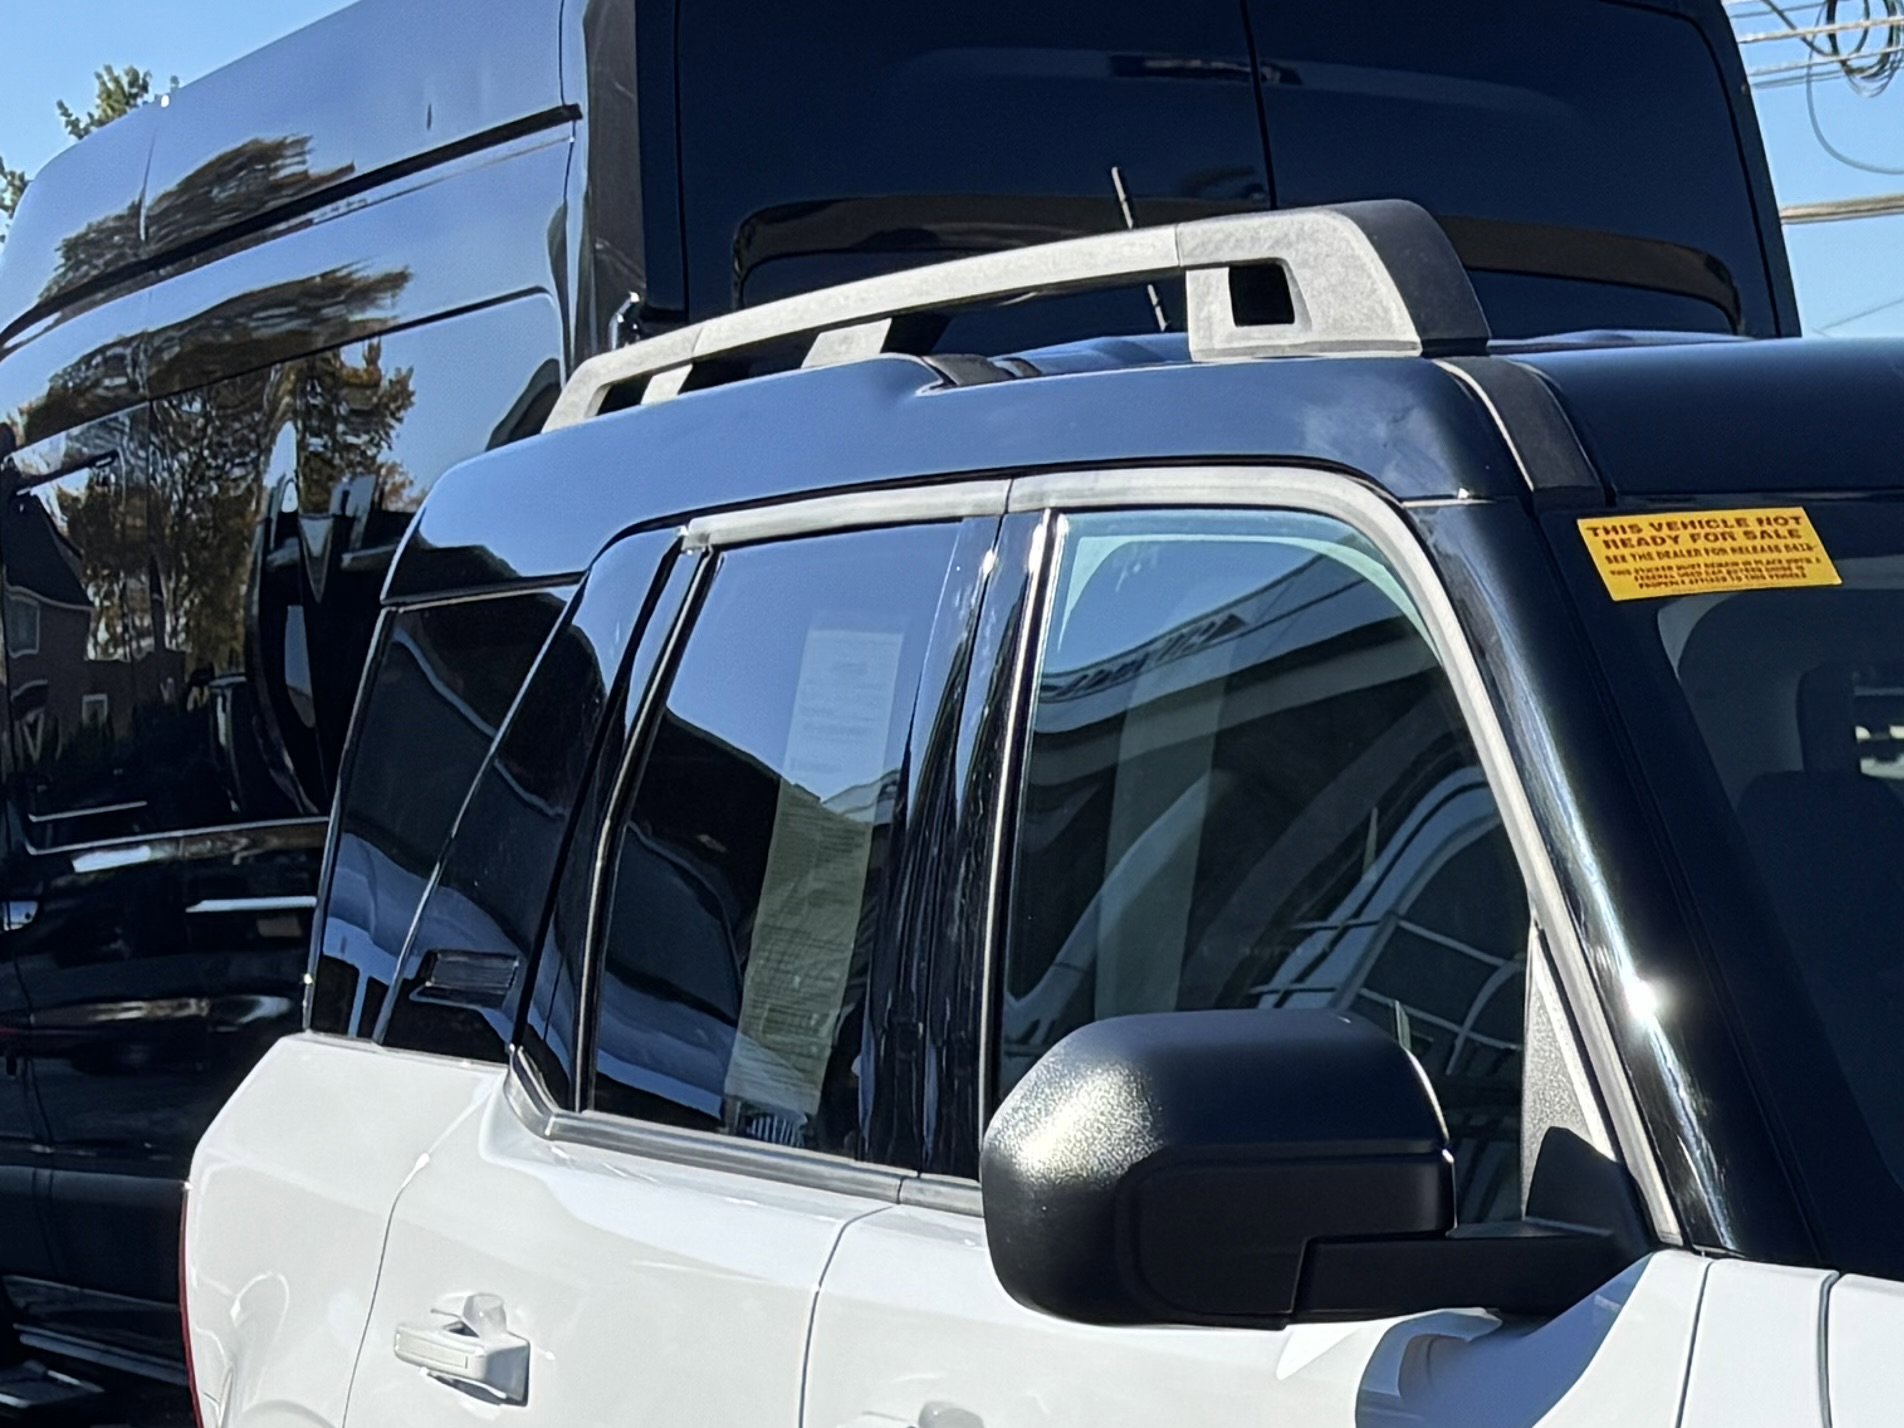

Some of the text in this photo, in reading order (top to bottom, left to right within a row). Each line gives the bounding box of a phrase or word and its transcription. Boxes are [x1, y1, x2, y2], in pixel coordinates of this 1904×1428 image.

[1585, 515, 1802, 537] THIS VEHICLE NOT
[1602, 529, 1802, 550] READY FOR SALE
[1655, 548, 1703, 561] DEALER
